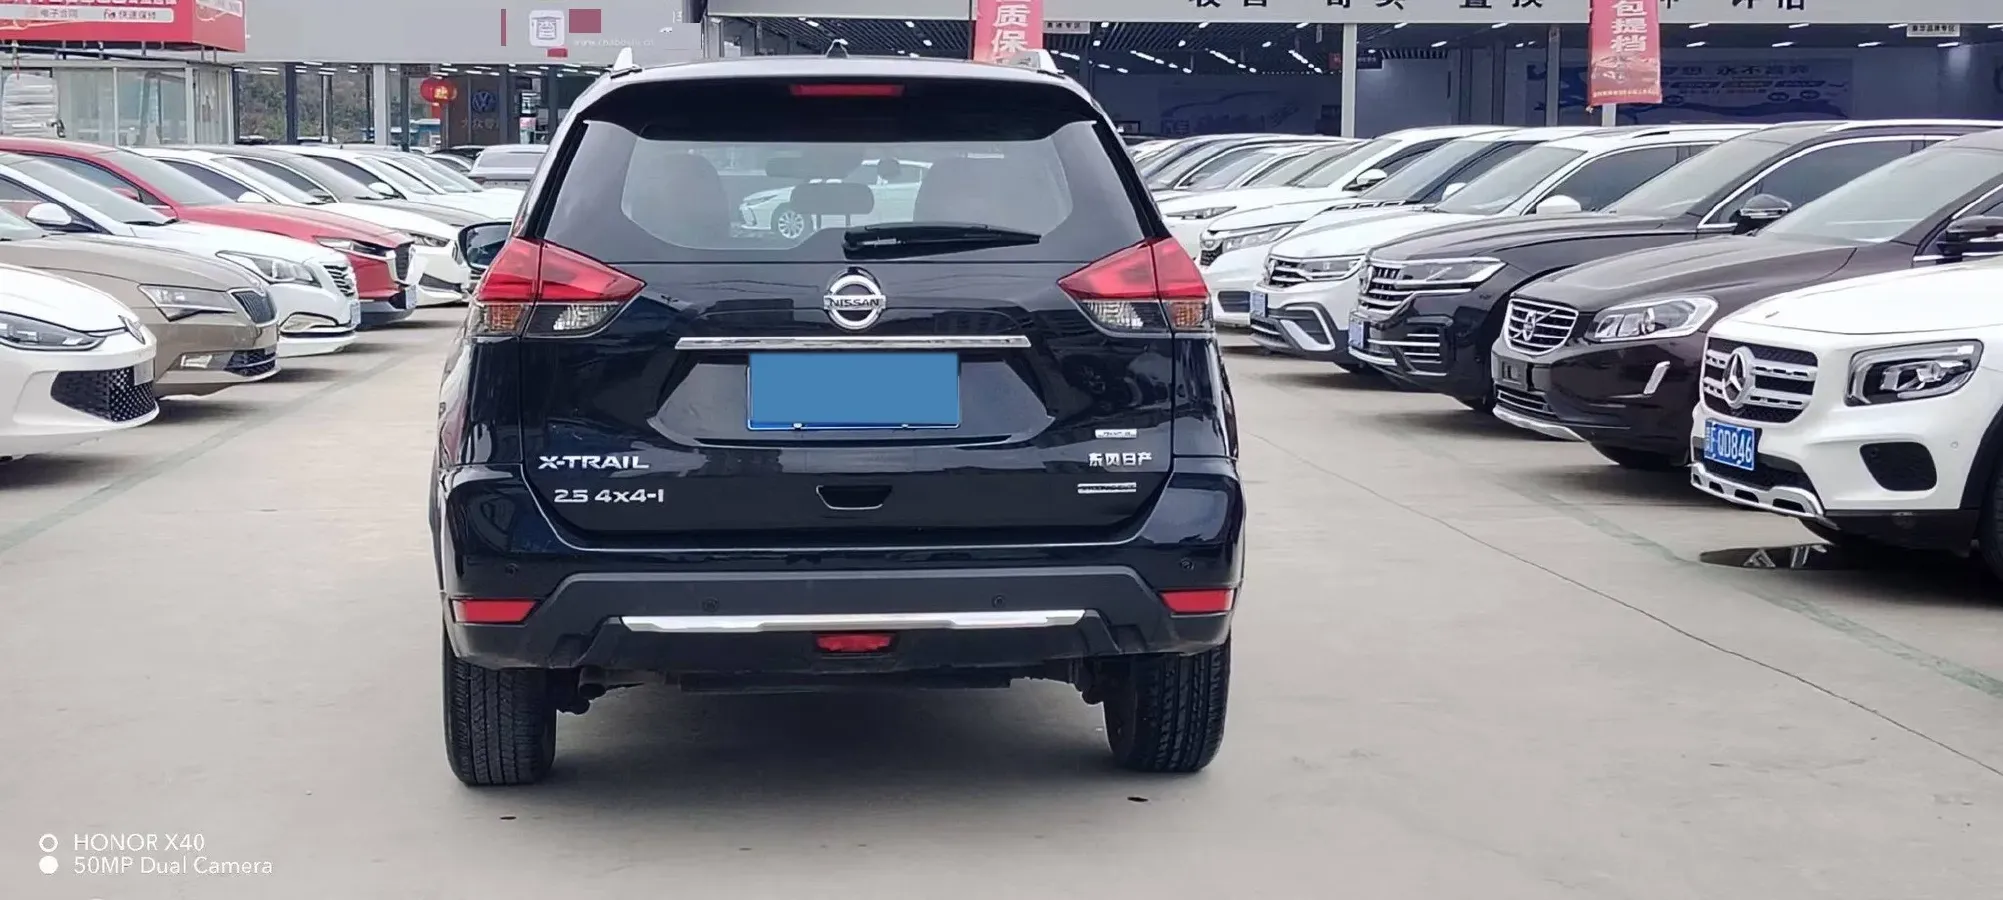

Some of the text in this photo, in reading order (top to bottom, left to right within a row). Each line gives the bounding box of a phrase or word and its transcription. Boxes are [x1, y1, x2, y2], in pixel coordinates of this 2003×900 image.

[993, 0, 1030, 52] 质保
[828, 298, 880, 307] NISSAN
[538, 455, 649, 470] X-TRAIL
[1088, 452, 1152, 467] 东风日产
